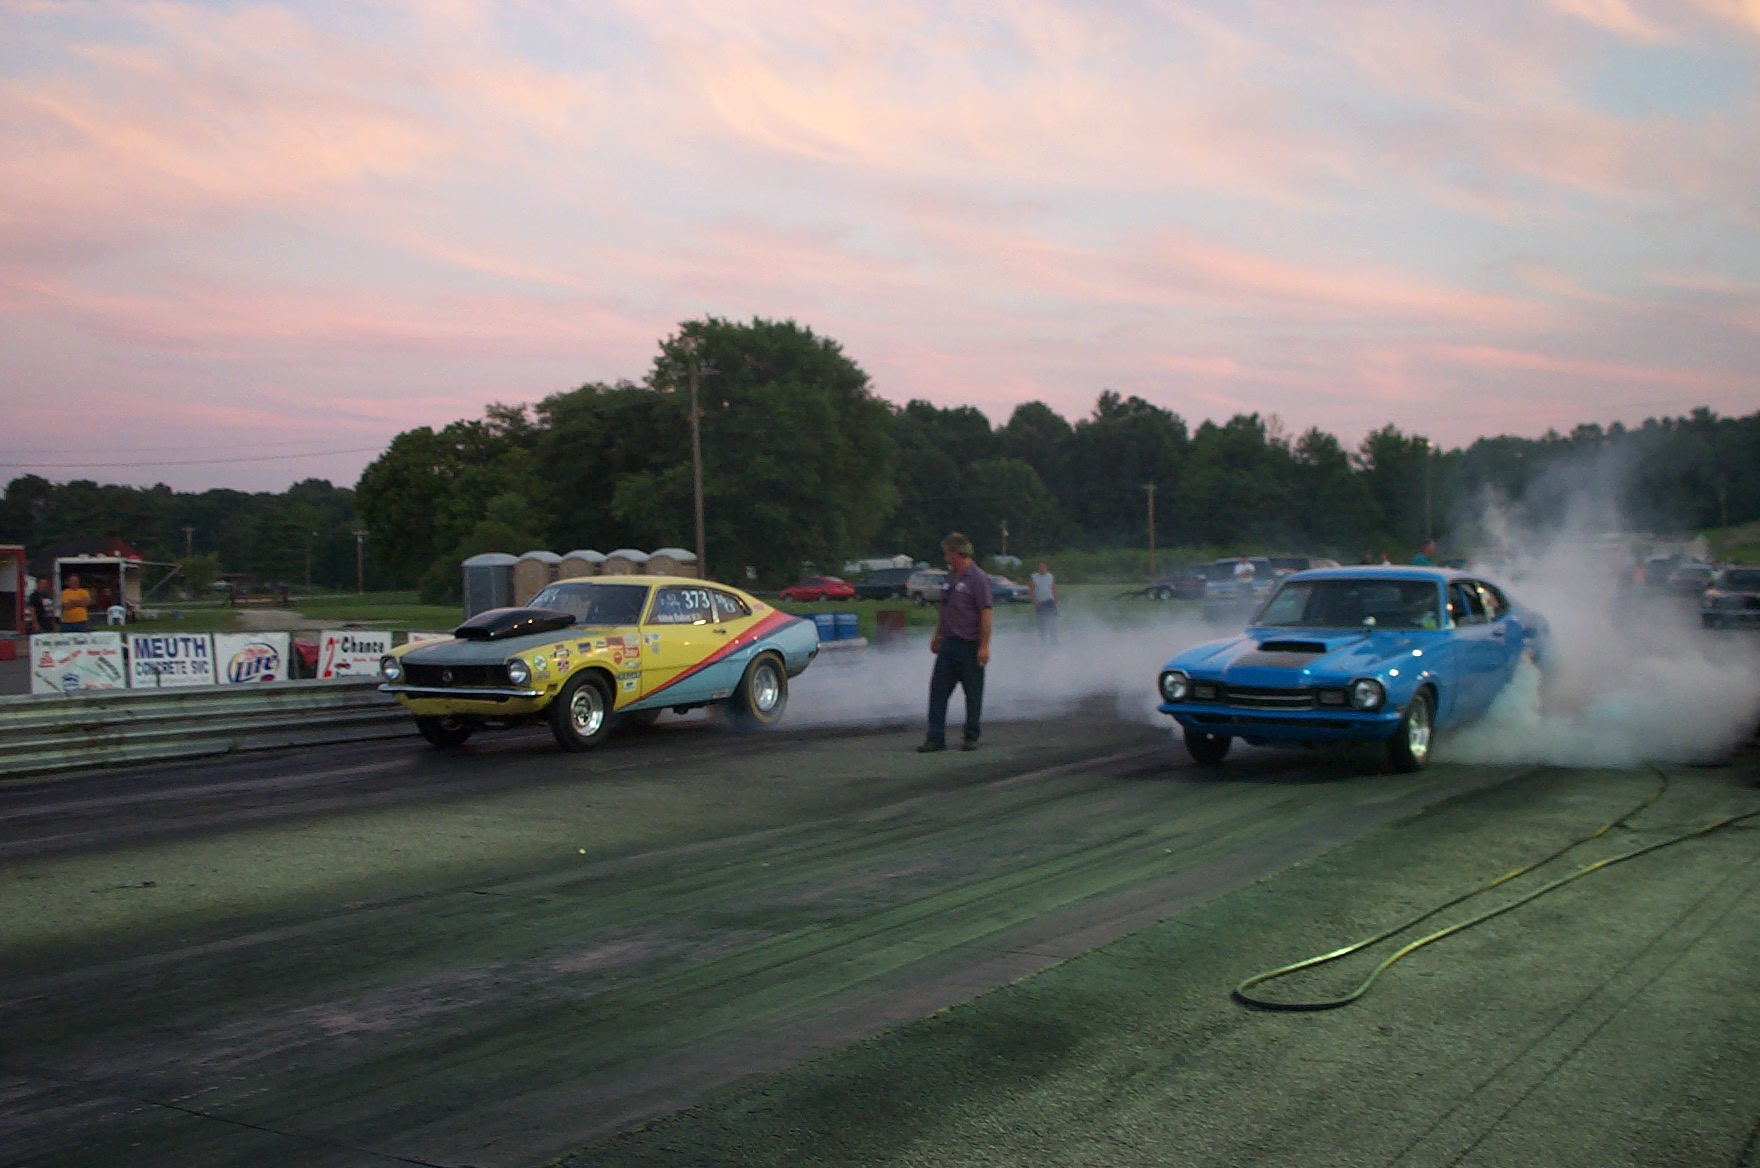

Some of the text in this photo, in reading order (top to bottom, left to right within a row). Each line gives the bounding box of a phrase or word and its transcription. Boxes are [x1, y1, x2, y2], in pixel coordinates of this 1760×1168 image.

[681, 590, 711, 609] 373
[134, 637, 207, 658] MEUTH
[341, 636, 385, 653] Chance
